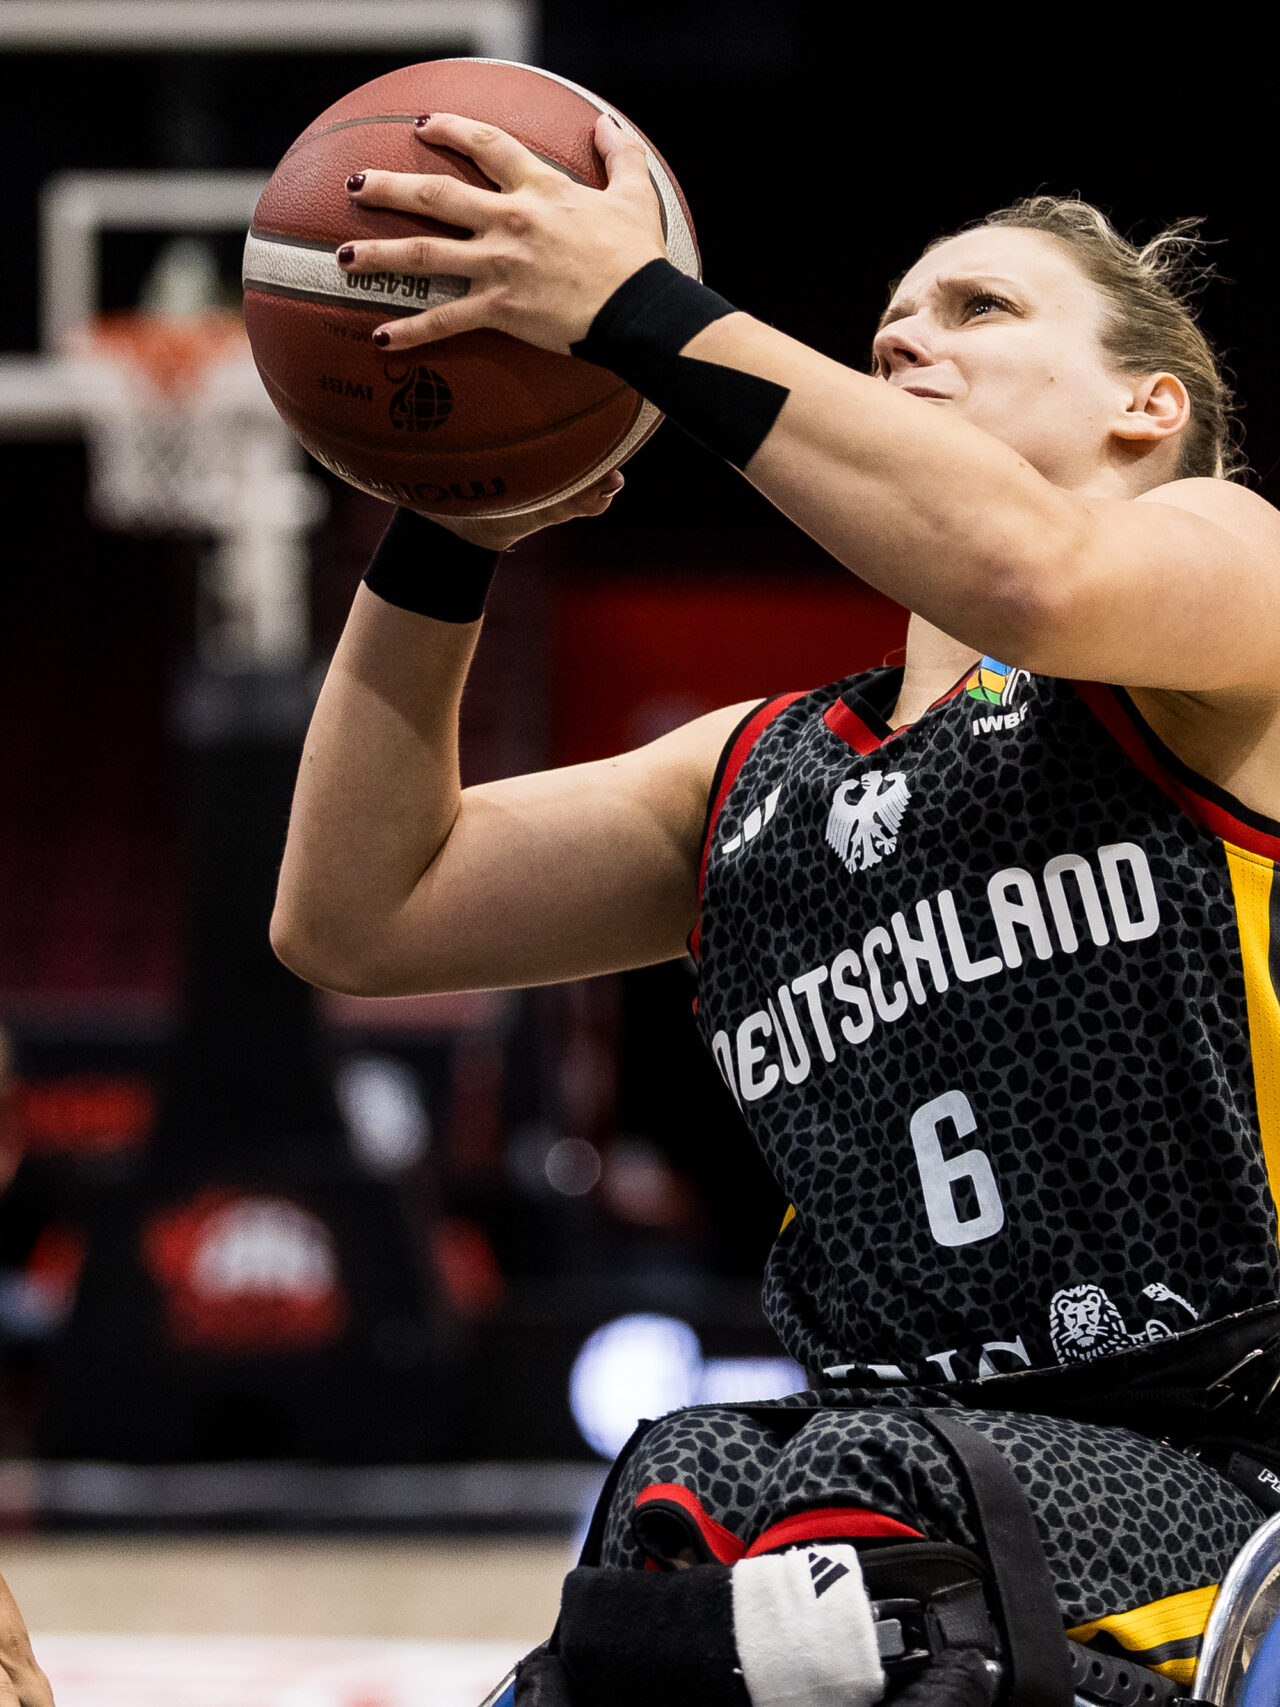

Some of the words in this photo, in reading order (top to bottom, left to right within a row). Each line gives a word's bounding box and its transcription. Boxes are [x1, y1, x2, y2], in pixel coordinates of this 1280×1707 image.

[345, 272, 431, 300] BG4500
[316, 374, 373, 402] IWBF
[972, 701, 1028, 736] IWBF
[712, 842, 1161, 1113] DEUTSCHLAND
[910, 1089, 1006, 1248] 6
